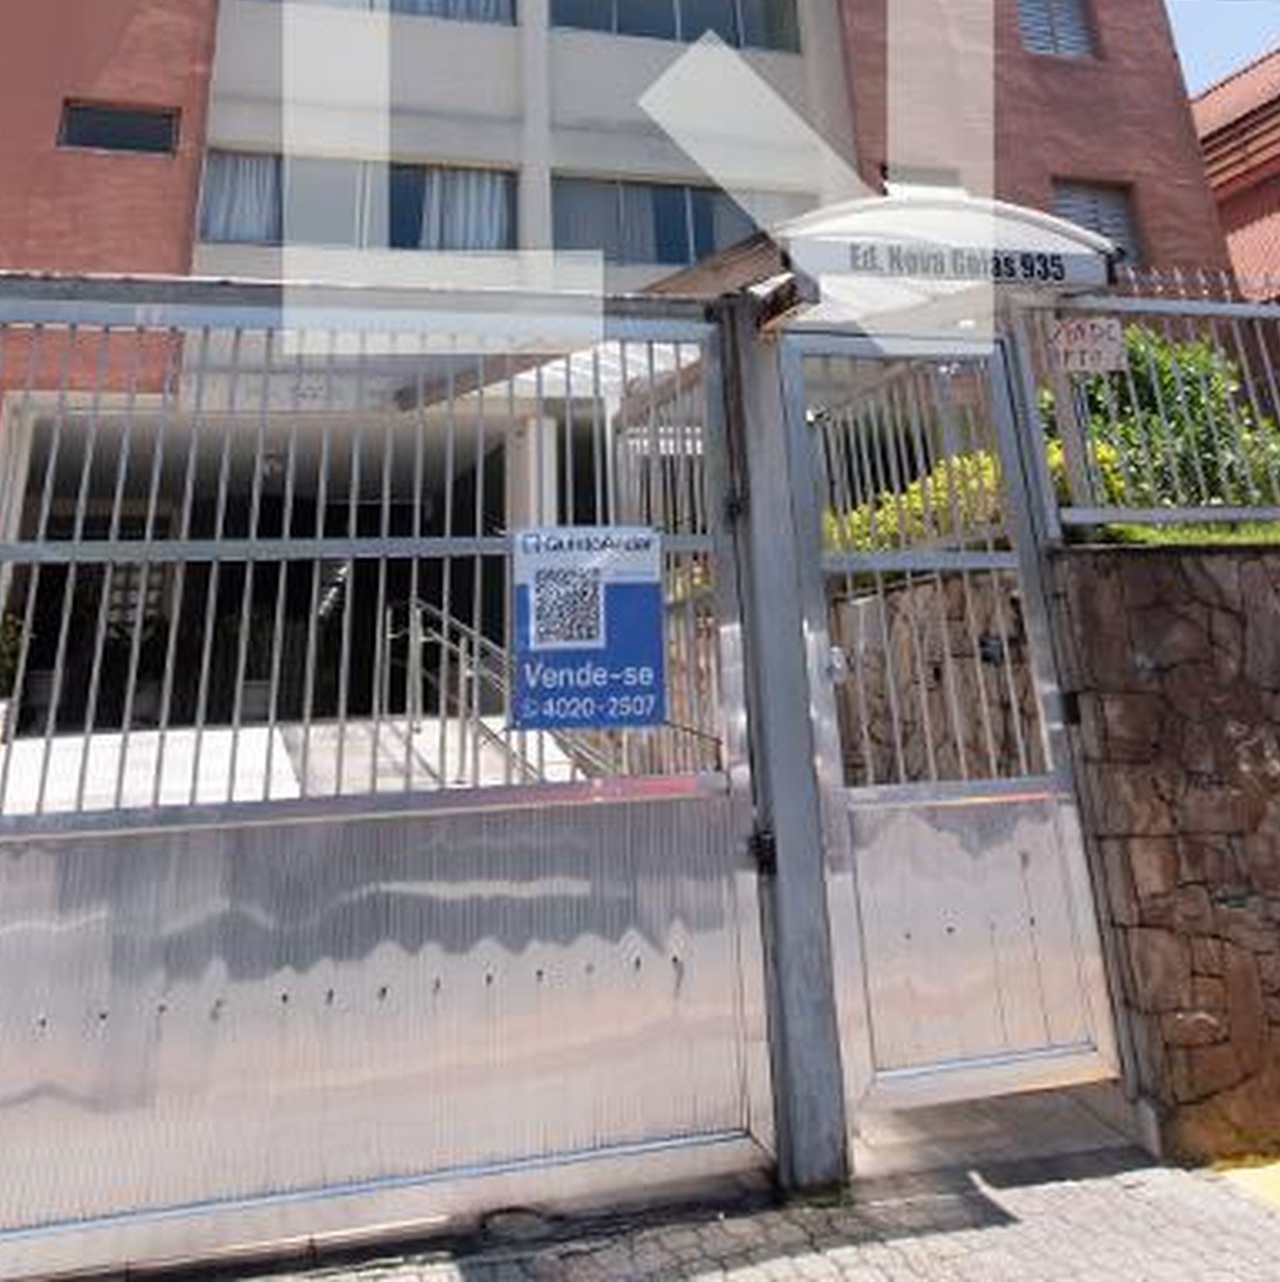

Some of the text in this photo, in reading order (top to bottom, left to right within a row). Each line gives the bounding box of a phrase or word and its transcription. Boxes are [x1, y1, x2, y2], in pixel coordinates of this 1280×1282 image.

[849, 243, 884, 272] Ed.
[887, 244, 945, 275] Nova
[1019, 252, 1066, 282] 935
[523, 661, 655, 689] Vende-se
